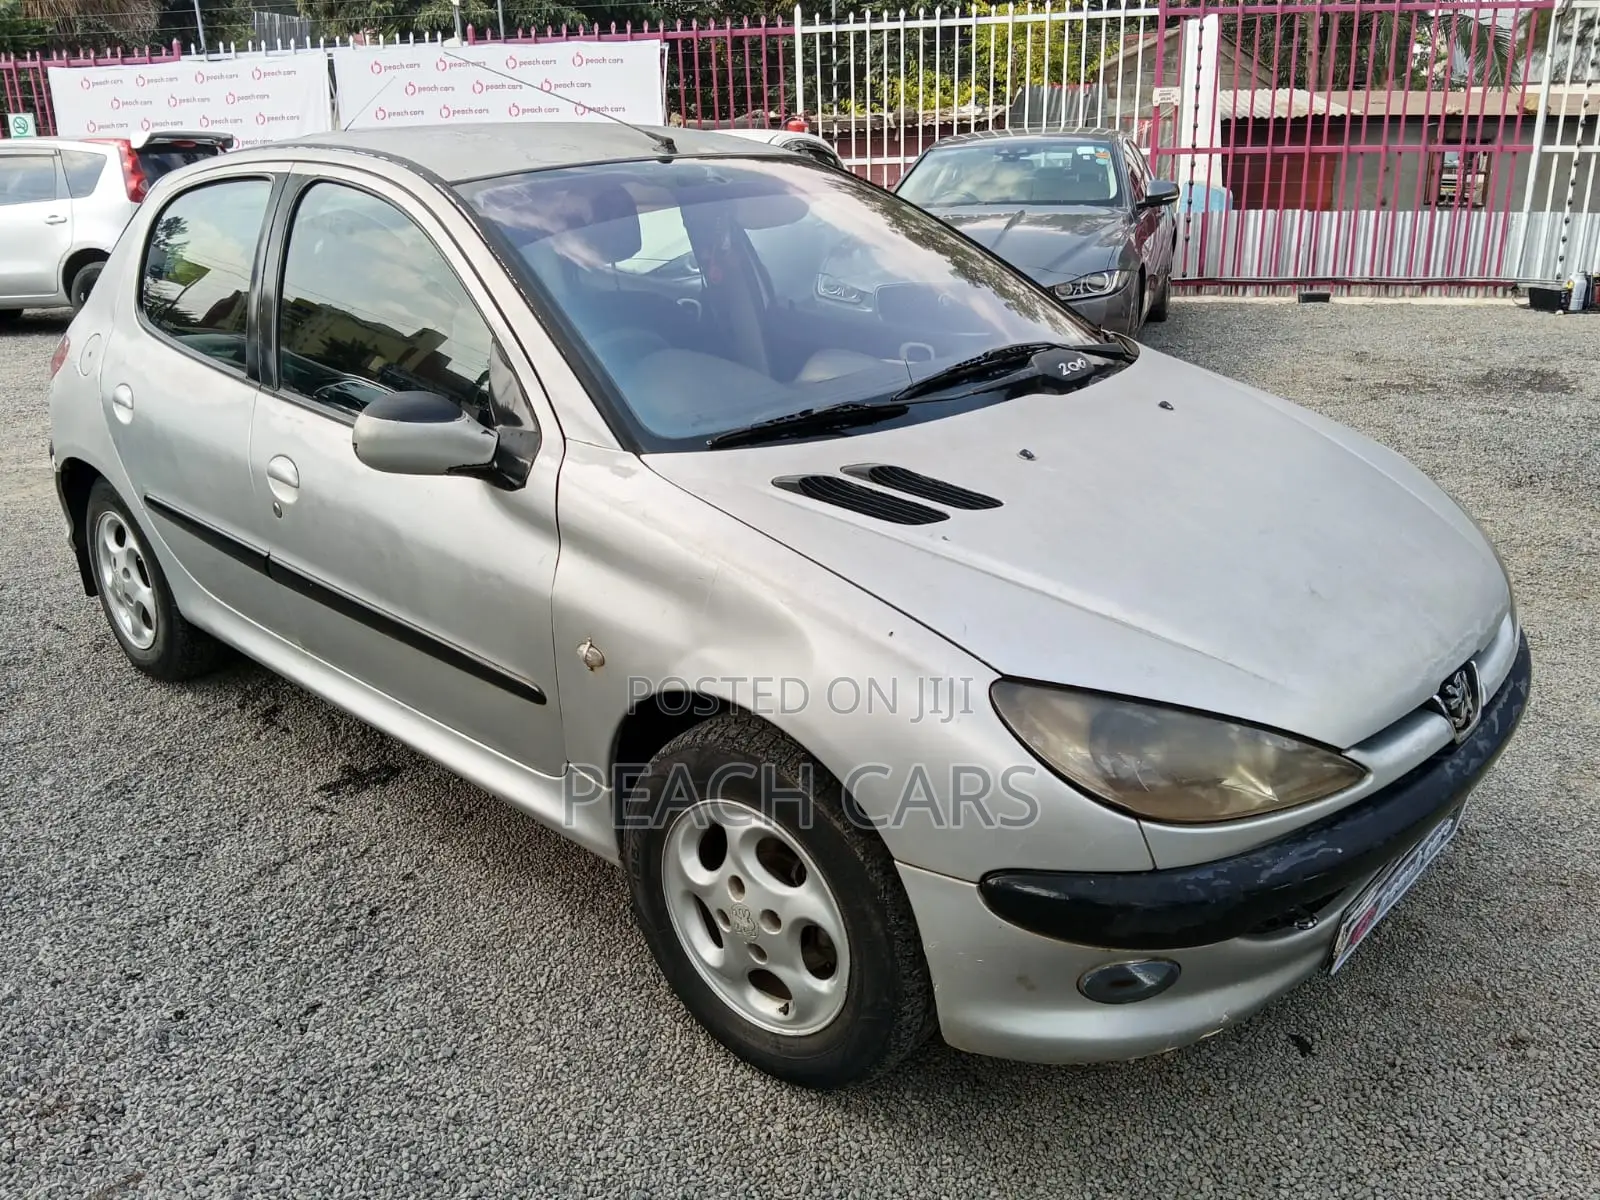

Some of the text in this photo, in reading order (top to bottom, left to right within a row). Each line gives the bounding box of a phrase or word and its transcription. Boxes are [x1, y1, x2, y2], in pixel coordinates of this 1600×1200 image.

[518, 59, 540, 67] peach
[585, 57, 607, 66] peach
[383, 63, 404, 72] peach
[263, 69, 282, 78] peach
[418, 84, 439, 93] peach
[485, 83, 507, 92] peach
[553, 81, 575, 90] peach
[121, 99, 140, 107] peach
[387, 108, 425, 117] peach cars
[452, 107, 474, 116] peach
[521, 106, 543, 115] peach
[210, 116, 229, 125] peach
[267, 113, 286, 122] peach
[1058, 358, 1086, 376] 206
